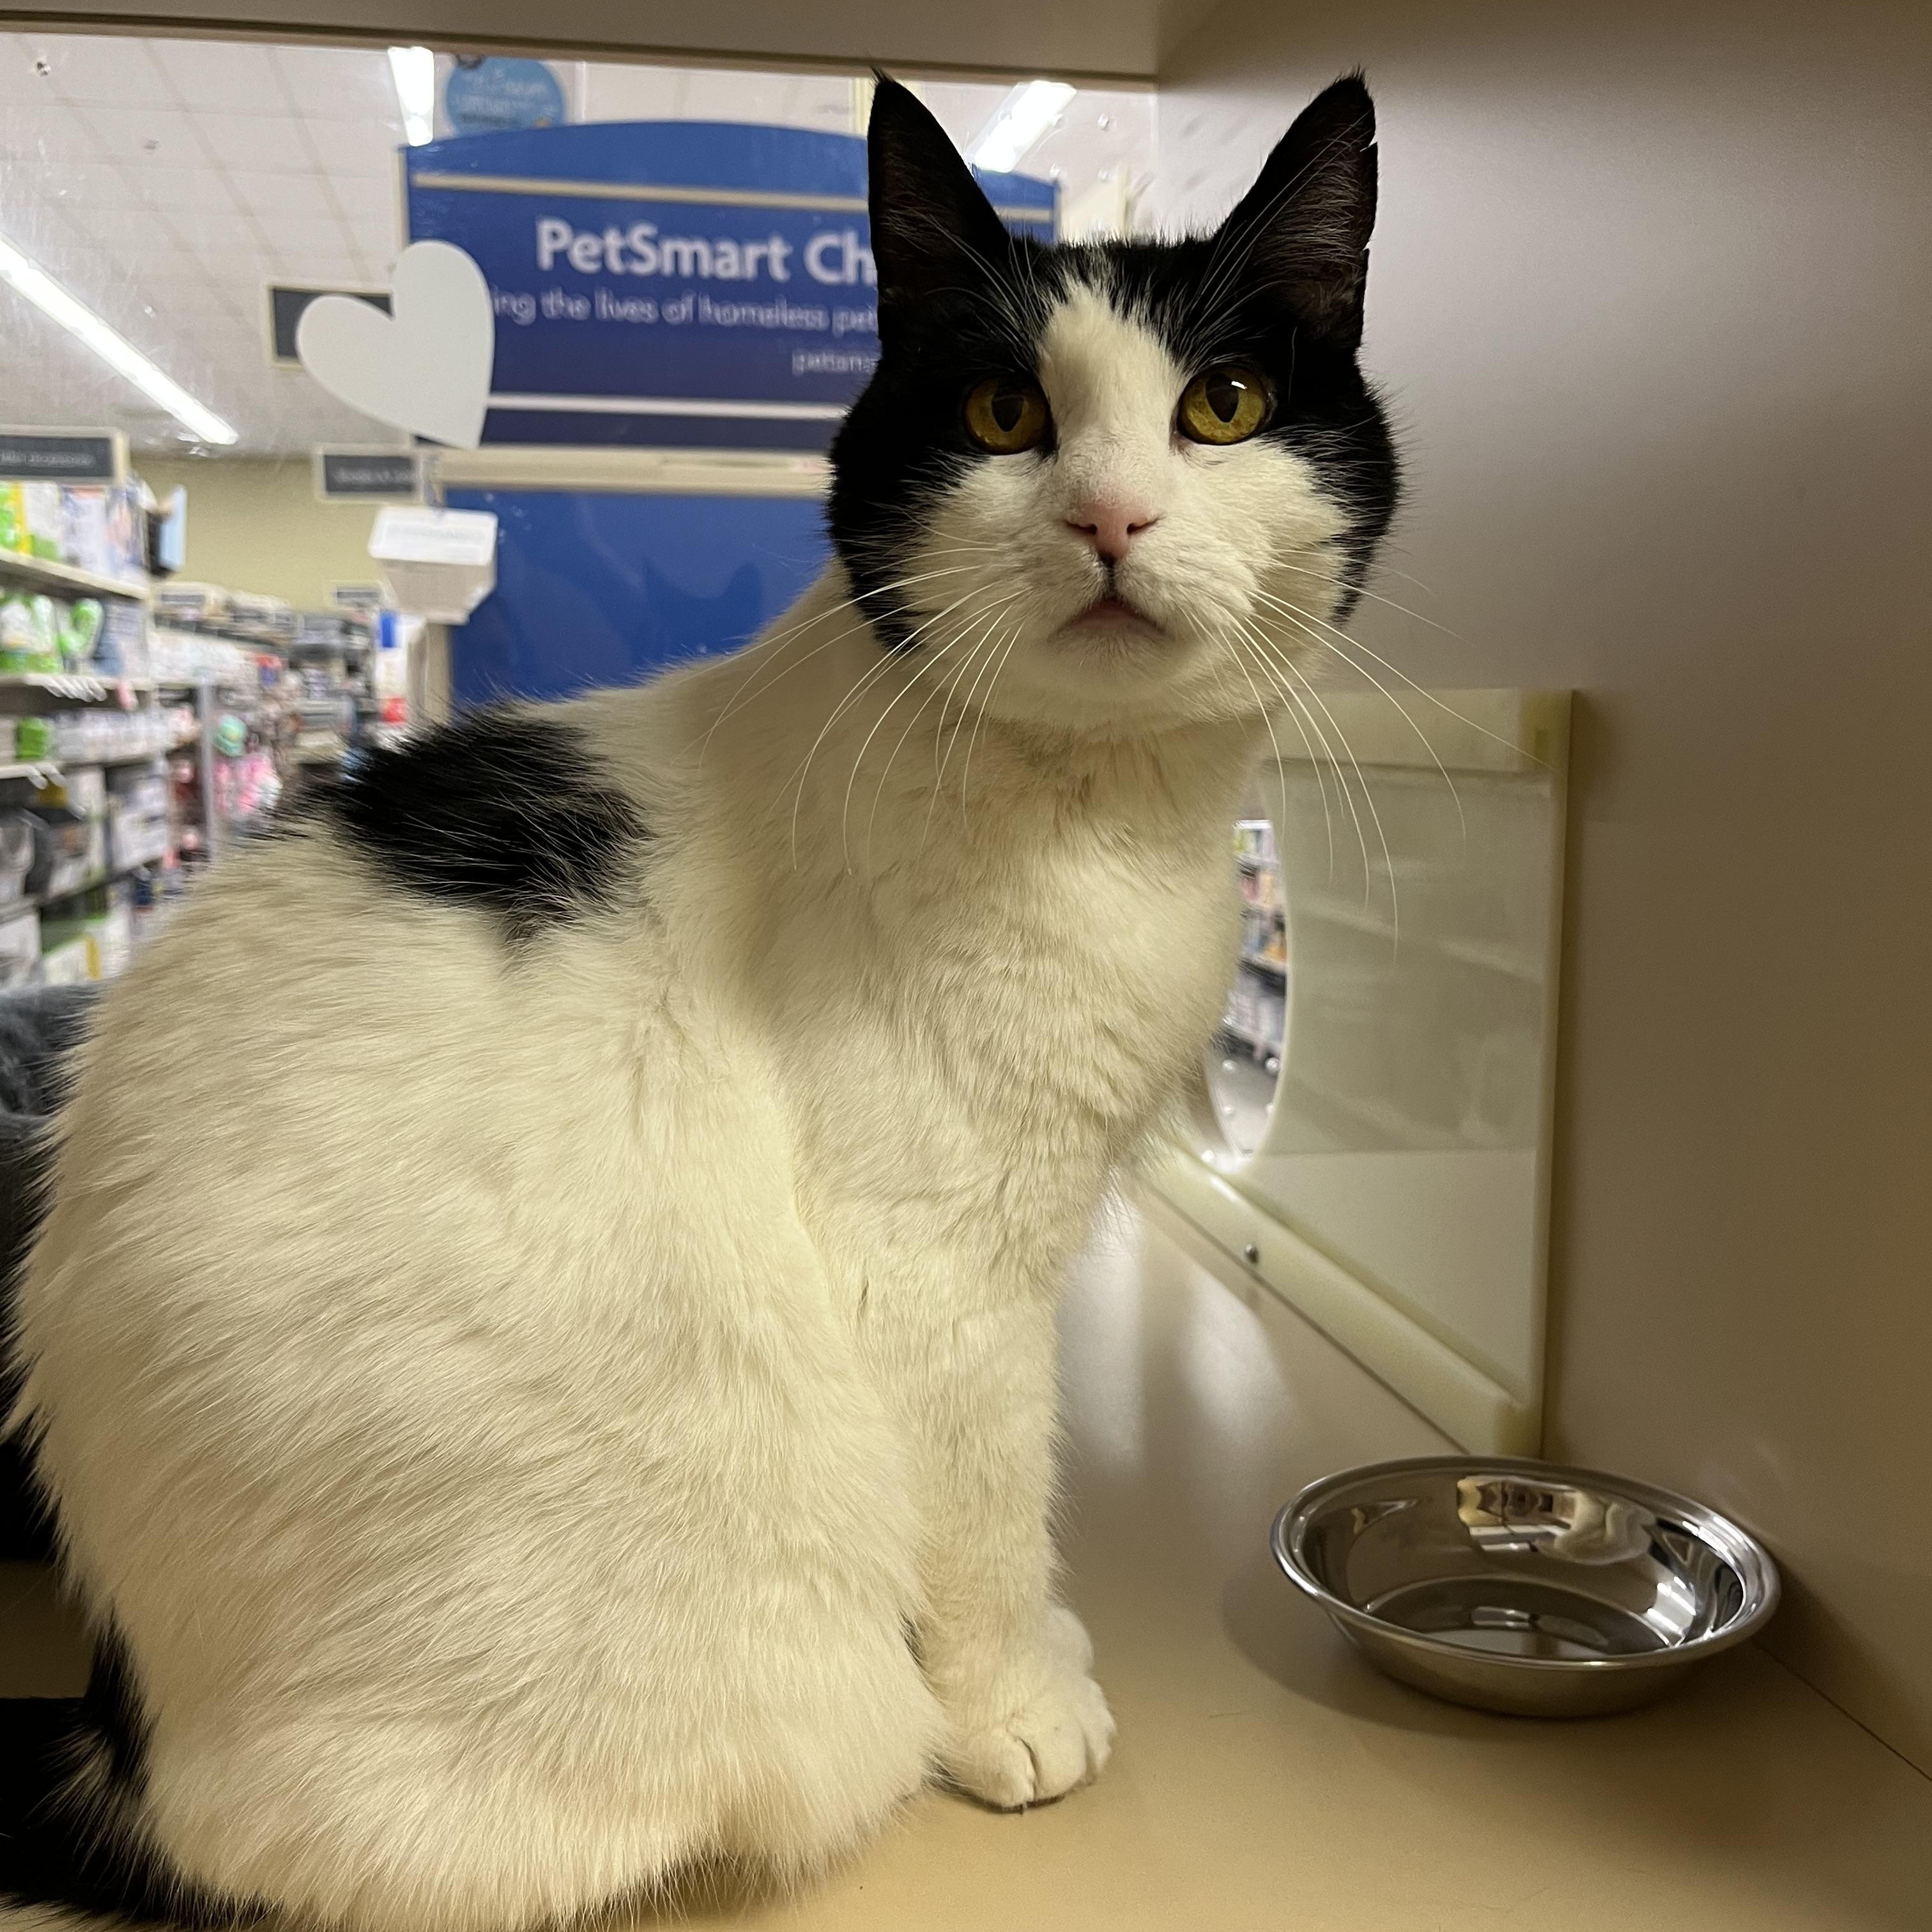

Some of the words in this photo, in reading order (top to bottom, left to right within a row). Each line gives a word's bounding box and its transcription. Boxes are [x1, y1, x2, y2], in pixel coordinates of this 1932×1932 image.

[536, 218, 793, 283] PetSmart
[541, 288, 592, 320] the
[595, 288, 659, 325] lives
[661, 290, 694, 325] of
[698, 291, 830, 332] homeless
